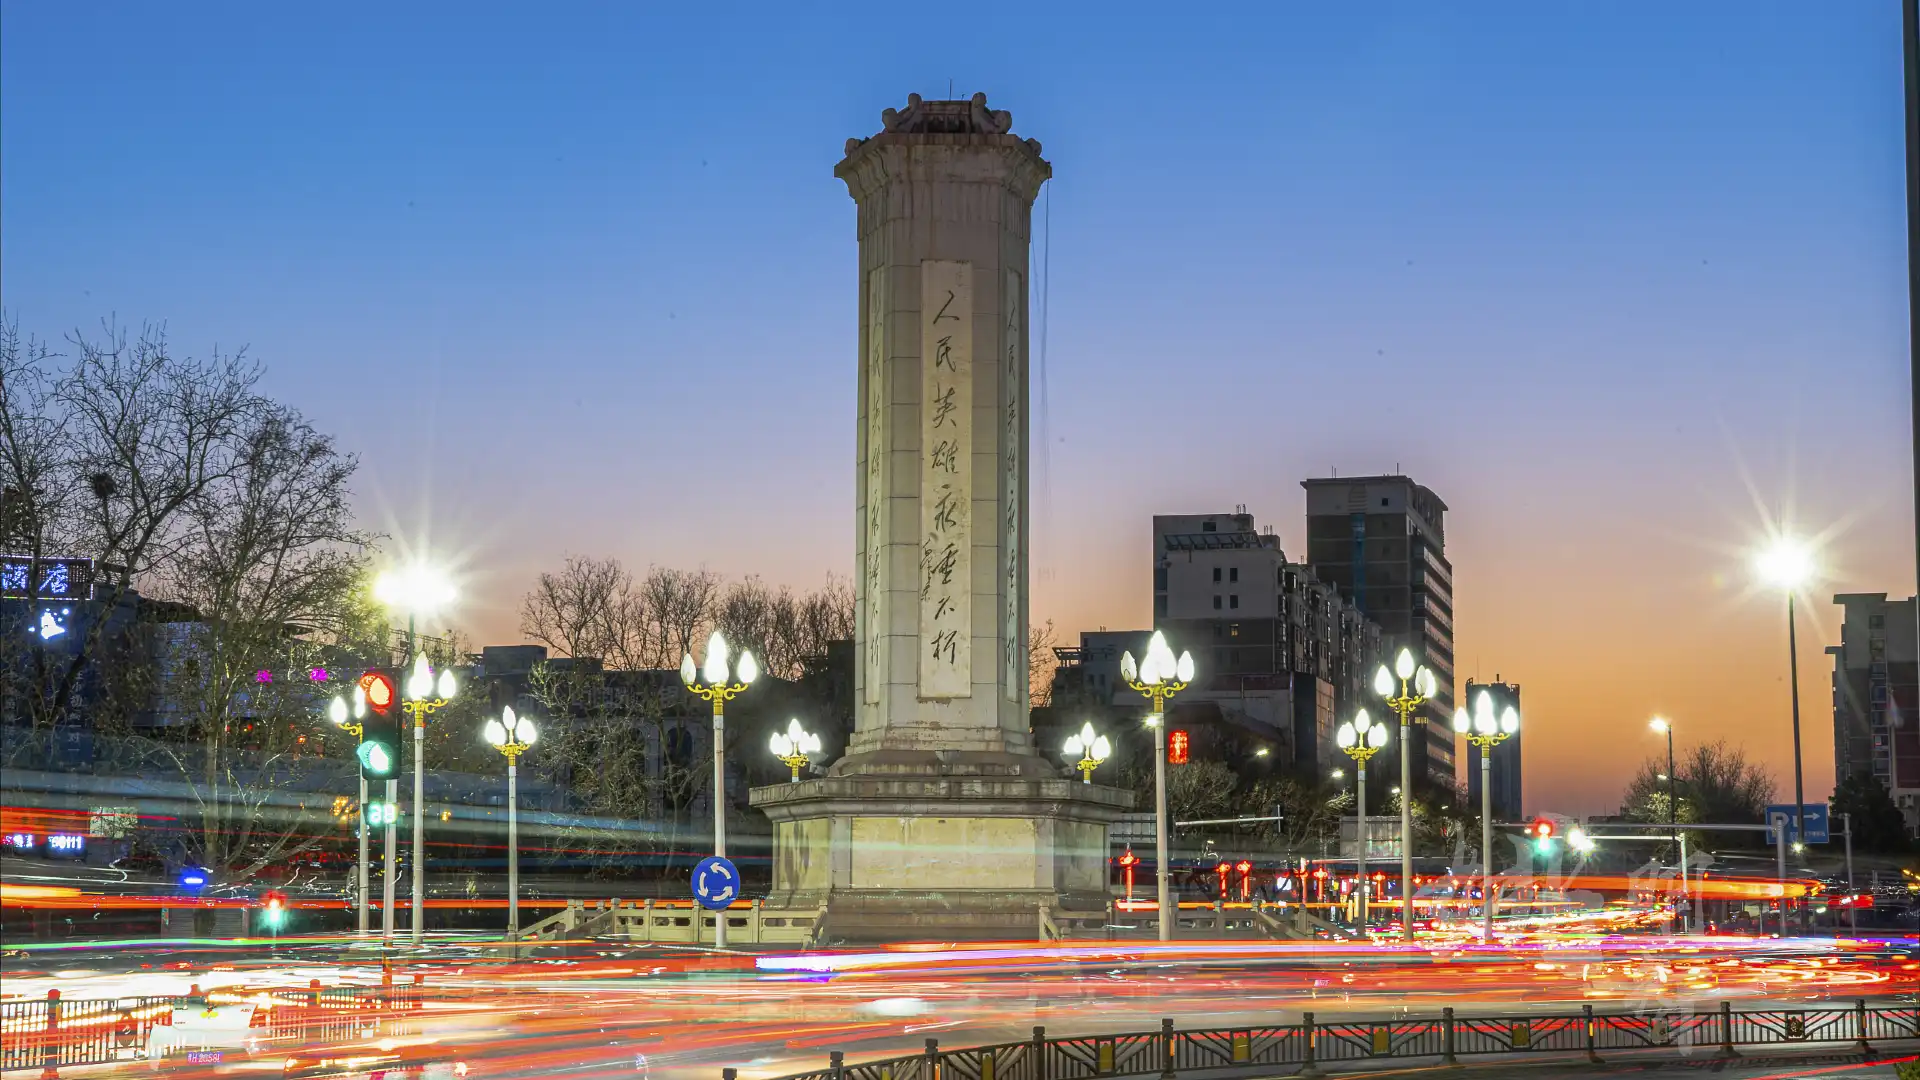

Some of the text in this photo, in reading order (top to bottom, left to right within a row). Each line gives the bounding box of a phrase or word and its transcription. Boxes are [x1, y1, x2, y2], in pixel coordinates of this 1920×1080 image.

[931, 290, 960, 666] 人民英雄永垂不朽
